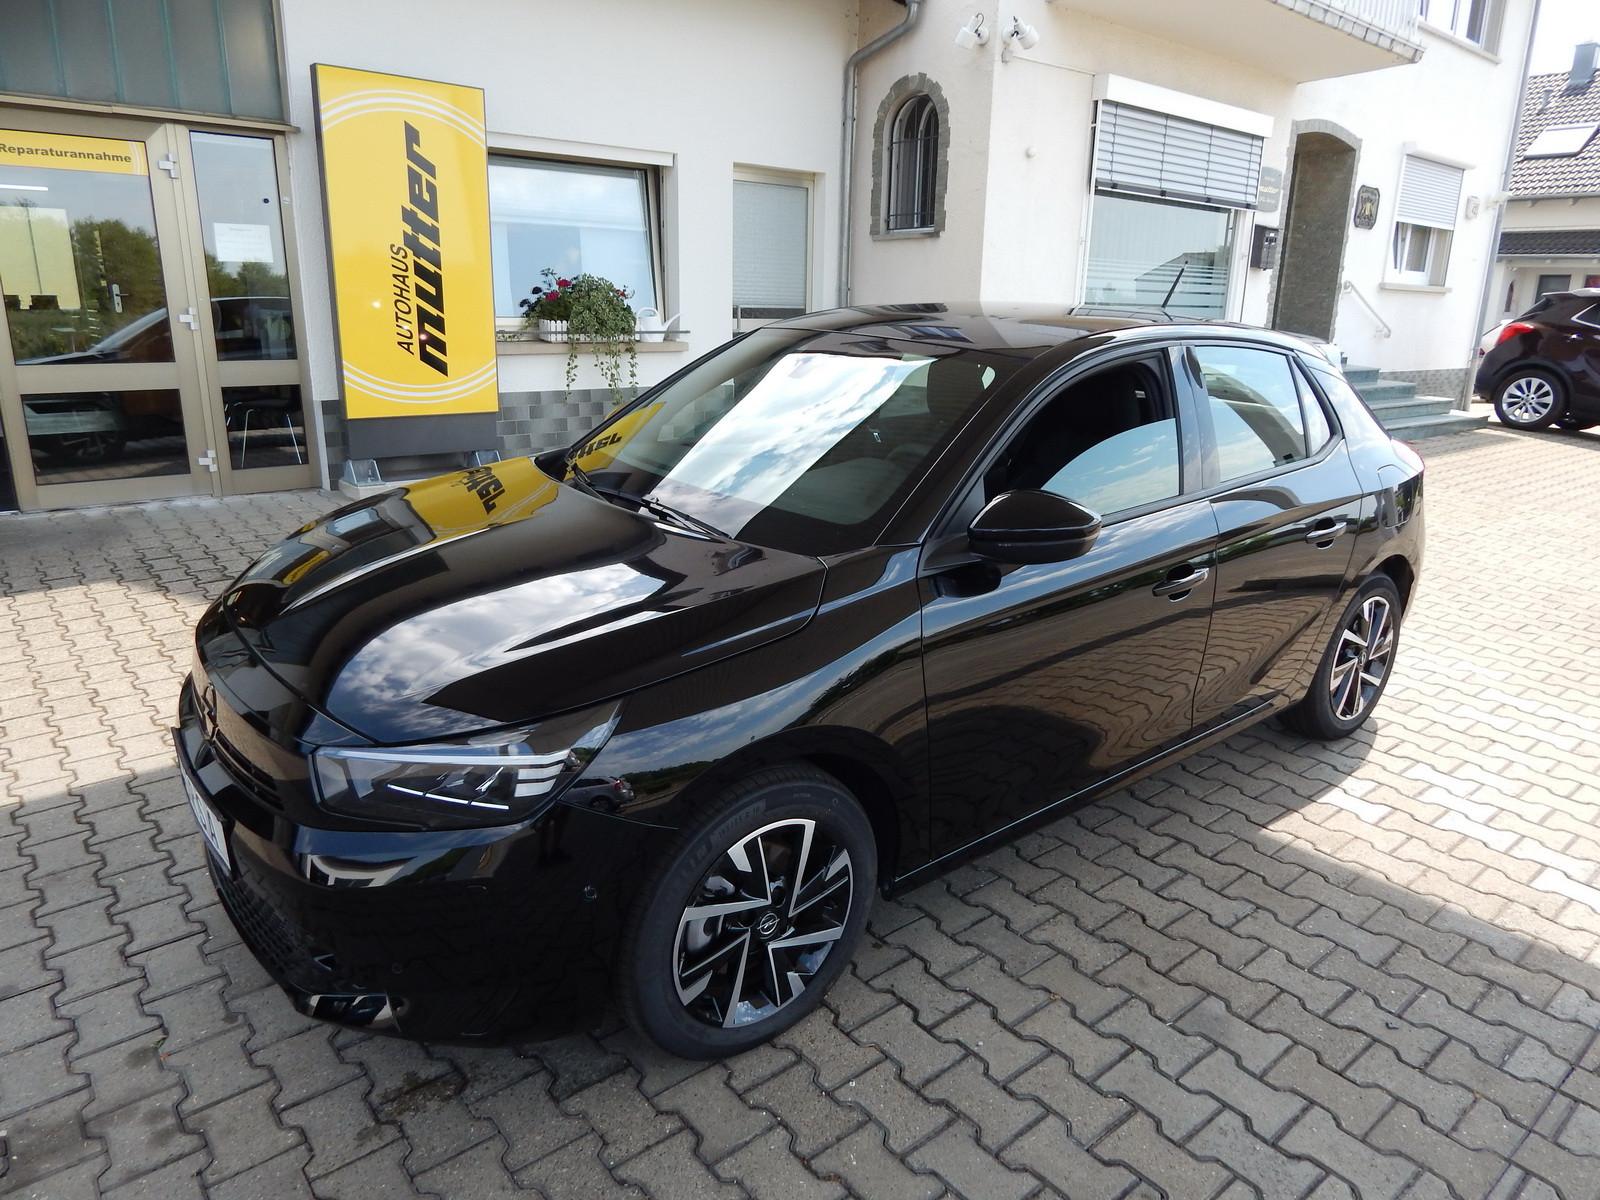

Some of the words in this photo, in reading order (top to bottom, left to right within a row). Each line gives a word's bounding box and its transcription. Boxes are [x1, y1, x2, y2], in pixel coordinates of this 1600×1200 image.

[0, 143, 132, 163] Reparaturannahme
[390, 243, 415, 356] AUTOHAUS
[401, 120, 449, 378] mutter
